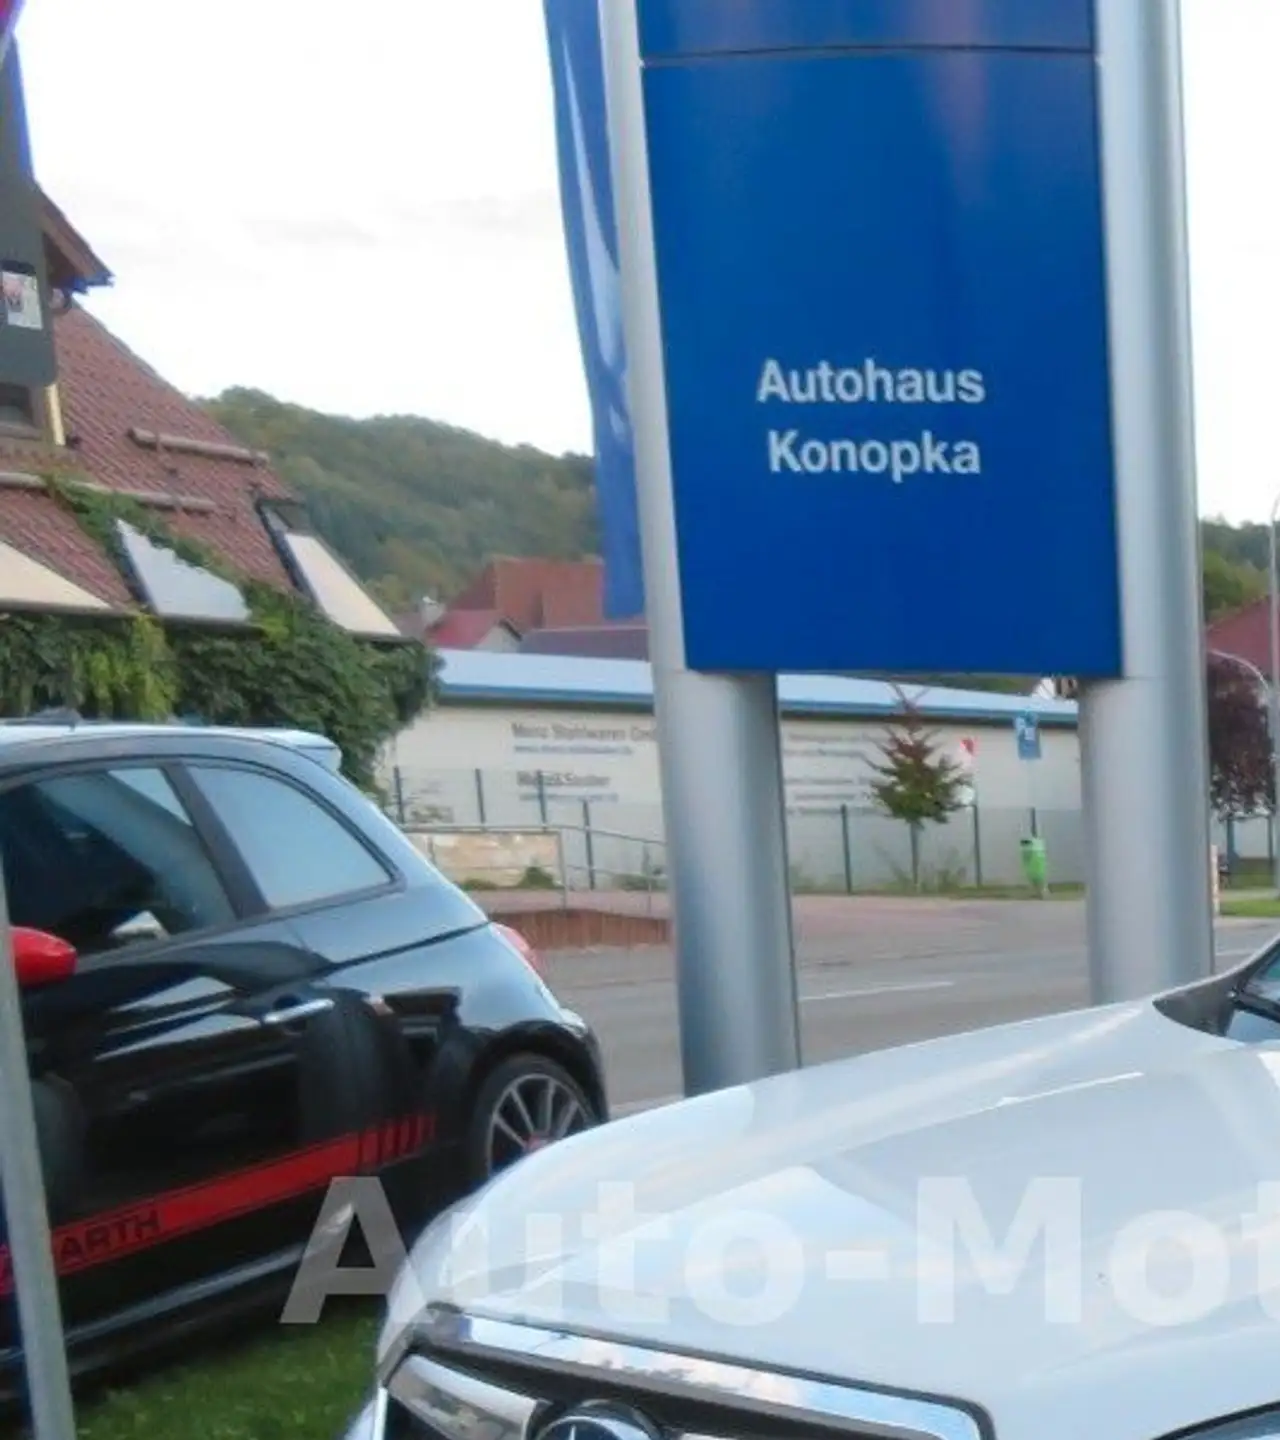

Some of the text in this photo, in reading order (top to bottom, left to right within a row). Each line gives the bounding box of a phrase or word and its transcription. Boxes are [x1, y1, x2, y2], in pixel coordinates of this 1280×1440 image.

[757, 358, 986, 403] Autohaus
[767, 429, 981, 484] Konopka
[58, 1208, 161, 1263] ARTH
